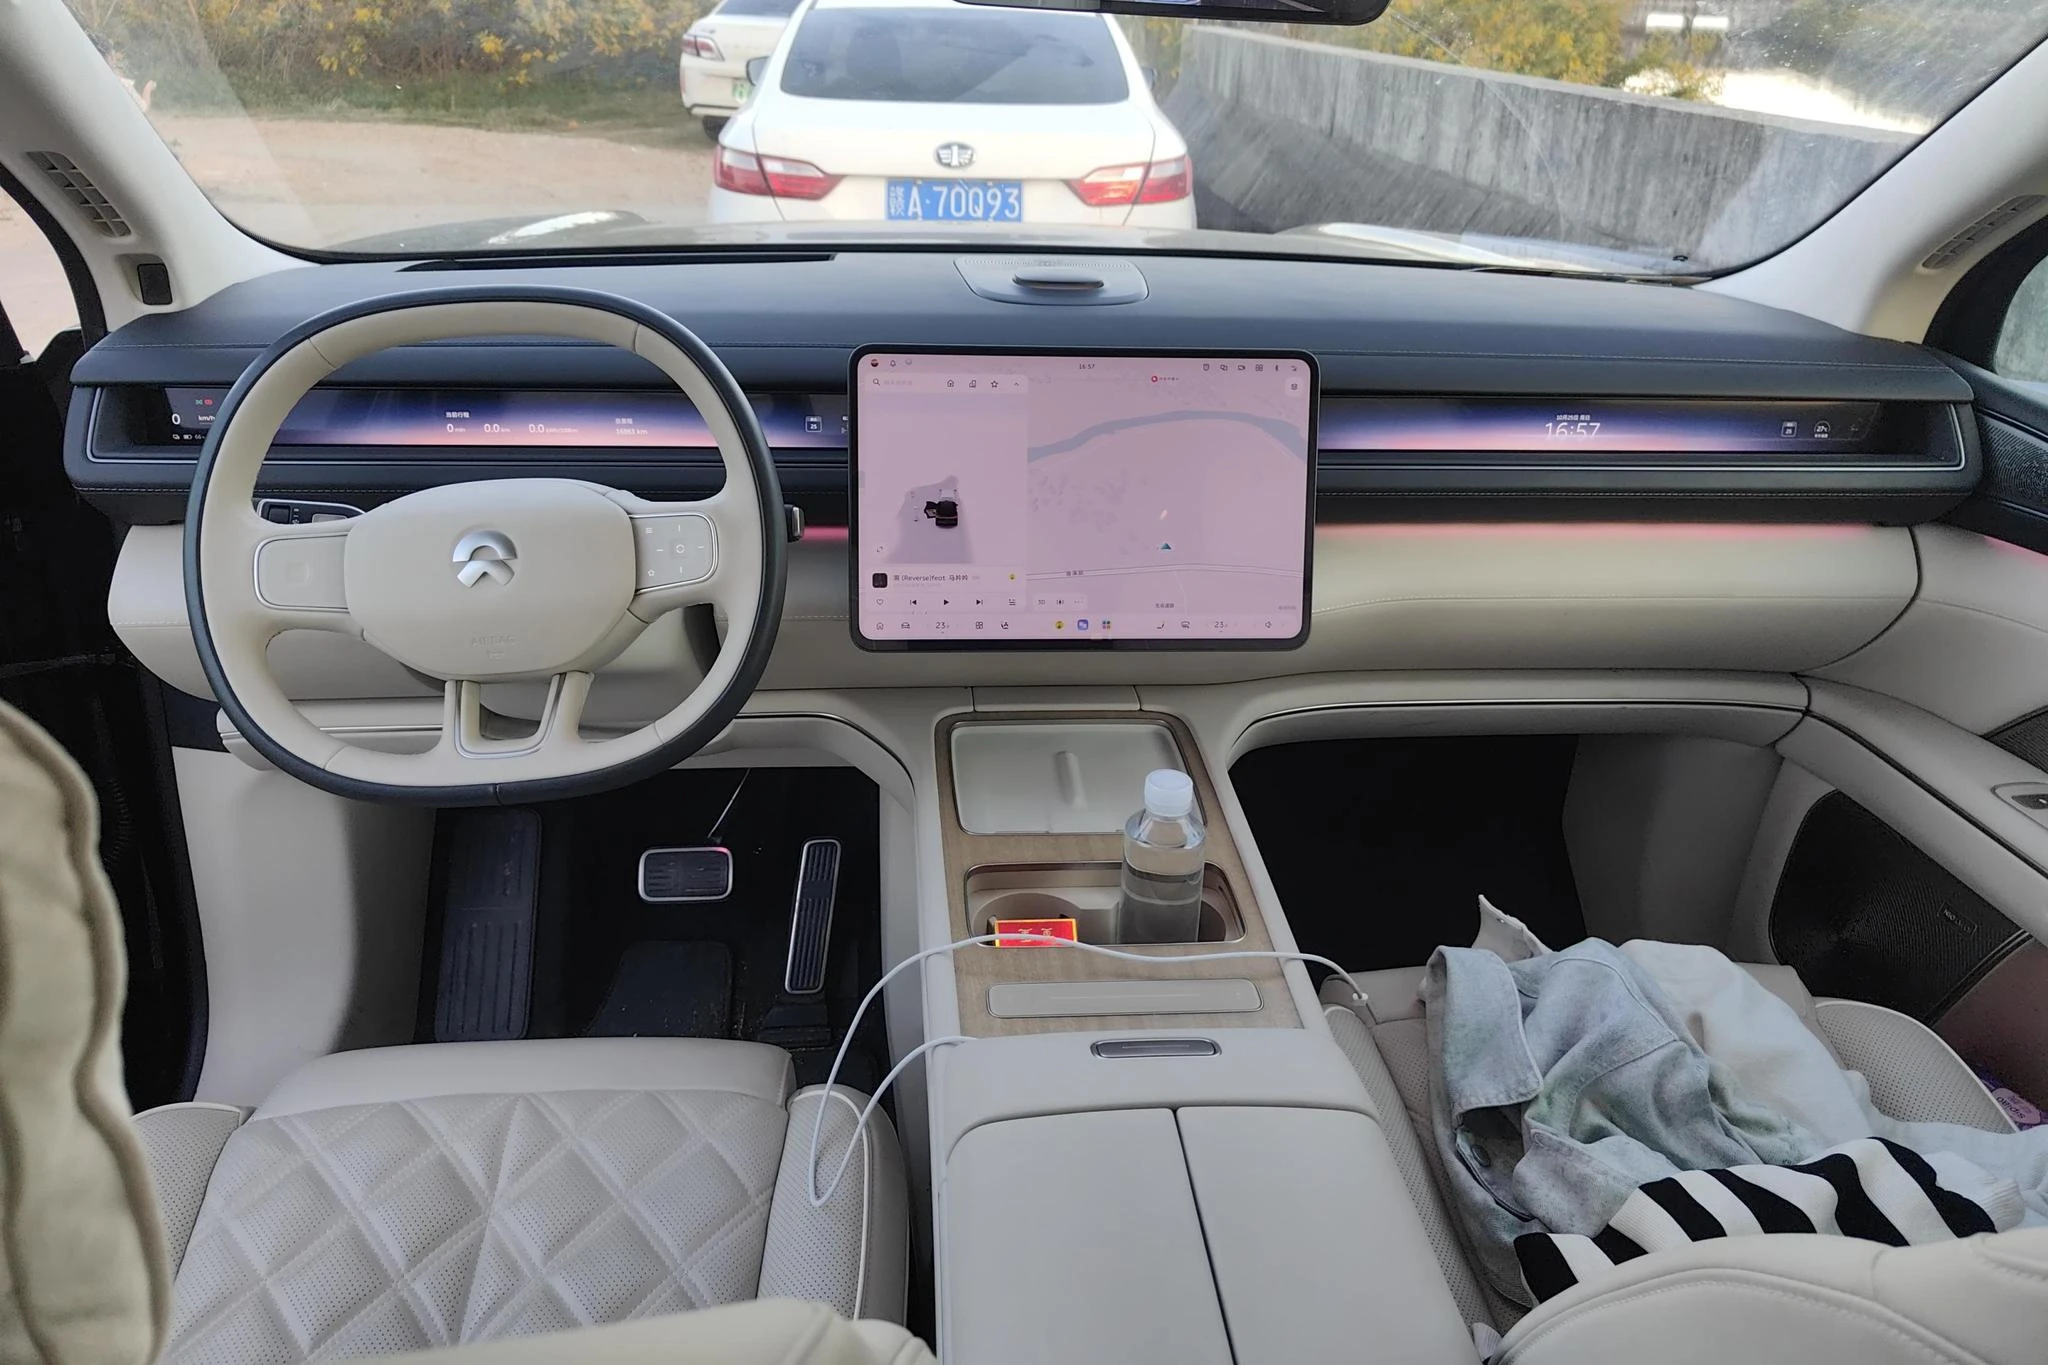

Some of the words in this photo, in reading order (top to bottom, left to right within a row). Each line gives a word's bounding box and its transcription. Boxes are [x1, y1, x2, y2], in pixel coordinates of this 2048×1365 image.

[171, 413, 181, 425] 0
[446, 423, 454, 432] 0
[484, 423, 500, 432] 0.0
[528, 423, 545, 433] 0.0
[1545, 422, 1601, 438] 16:57
